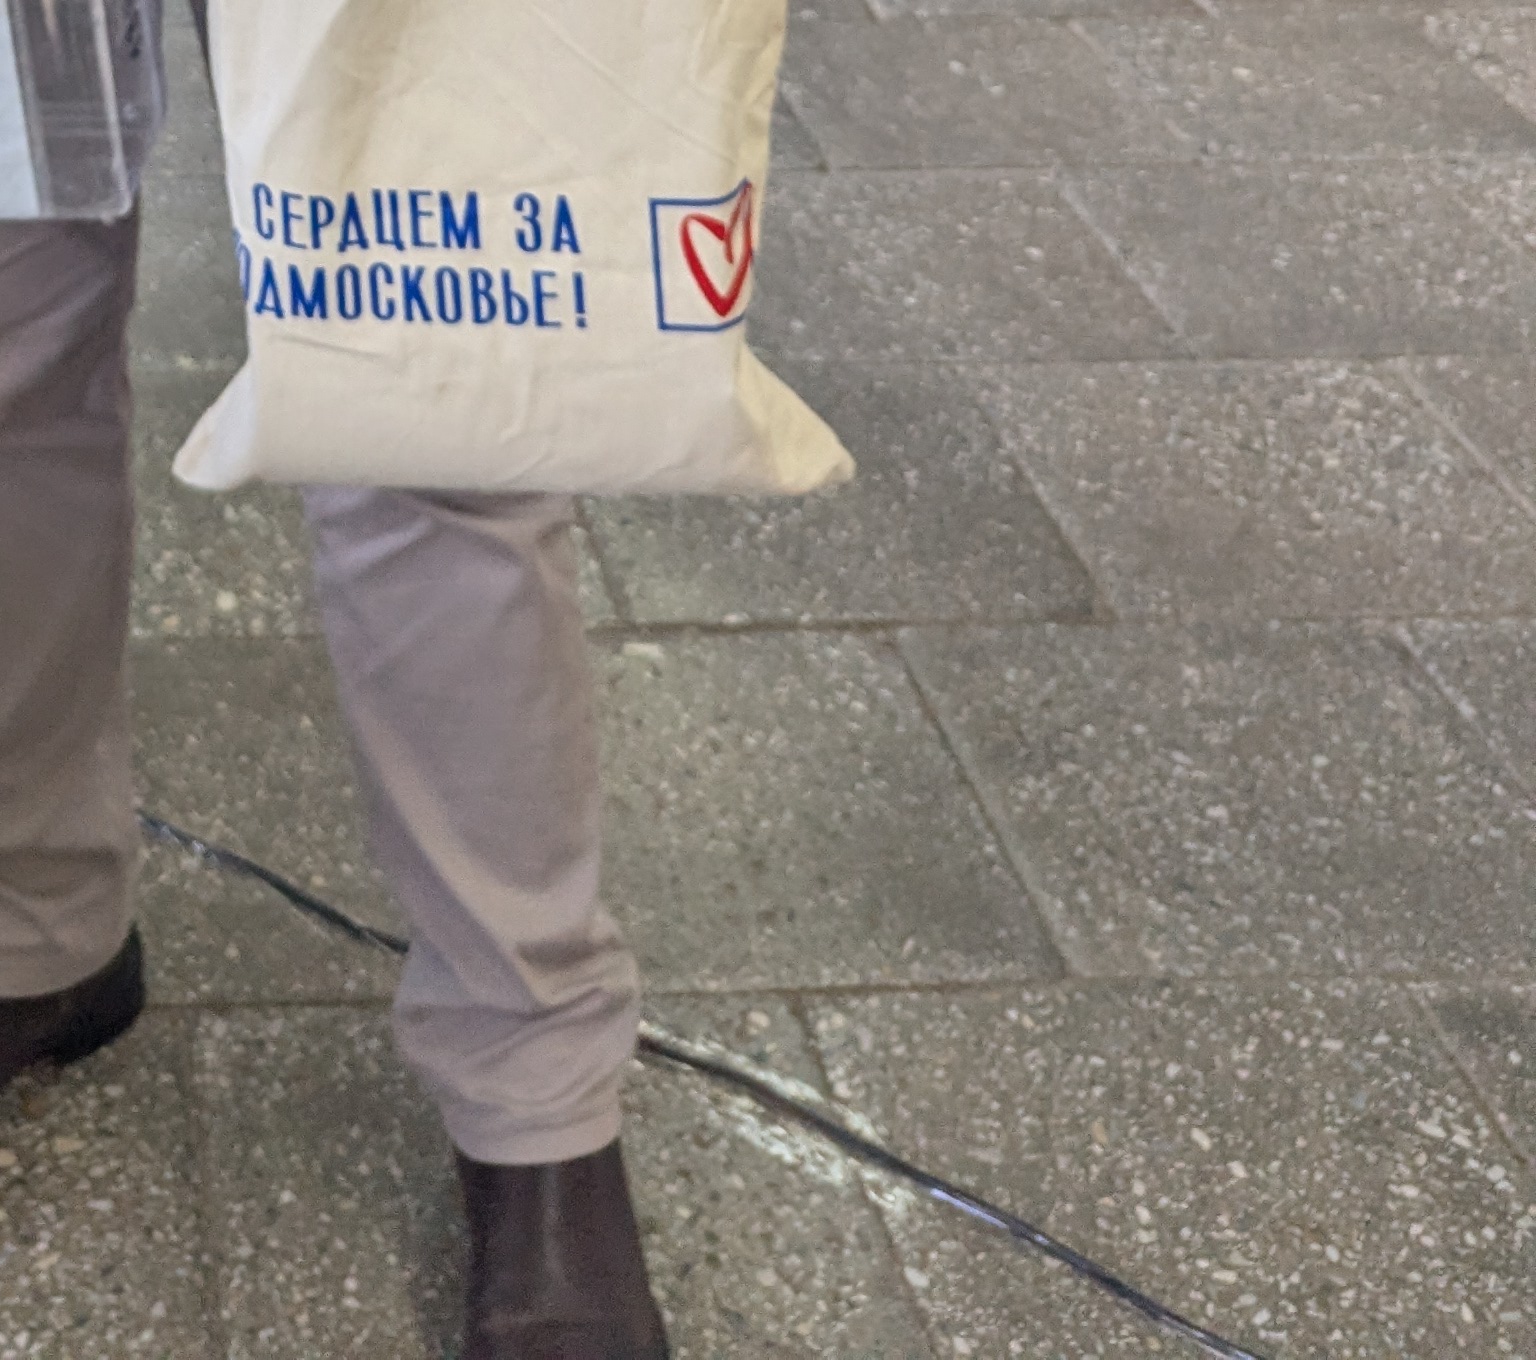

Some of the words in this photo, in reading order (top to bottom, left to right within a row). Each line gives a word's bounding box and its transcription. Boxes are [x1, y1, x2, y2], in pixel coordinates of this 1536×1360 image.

[251, 182, 482, 254] СЕРДЦЕМ
[513, 191, 581, 255] ЗА
[232, 227, 588, 329] ОДМОСКОВЬЕ!
